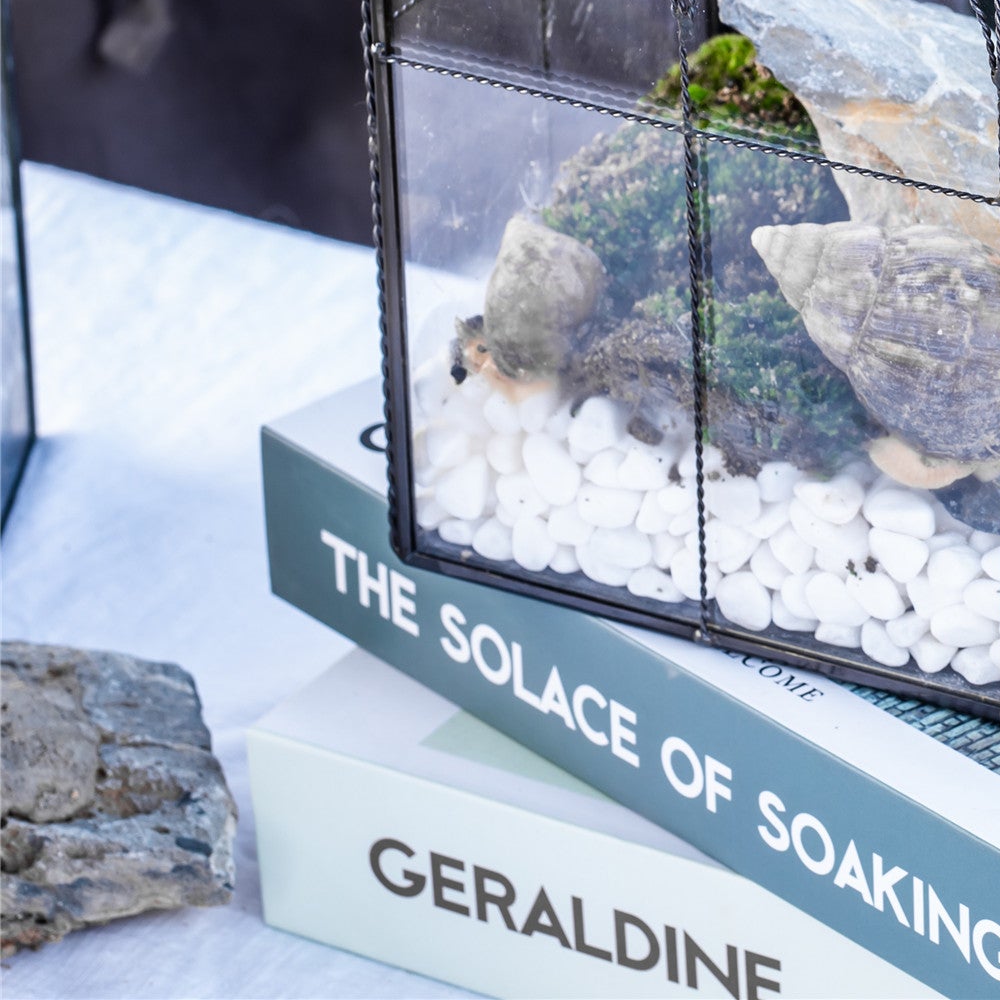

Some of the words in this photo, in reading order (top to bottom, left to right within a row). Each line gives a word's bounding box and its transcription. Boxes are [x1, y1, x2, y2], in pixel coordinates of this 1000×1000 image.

[321, 529, 420, 637] THE
[439, 603, 640, 768] SOLACE
[661, 736, 733, 813] OF
[369, 838, 782, 1000] GERALDINE
